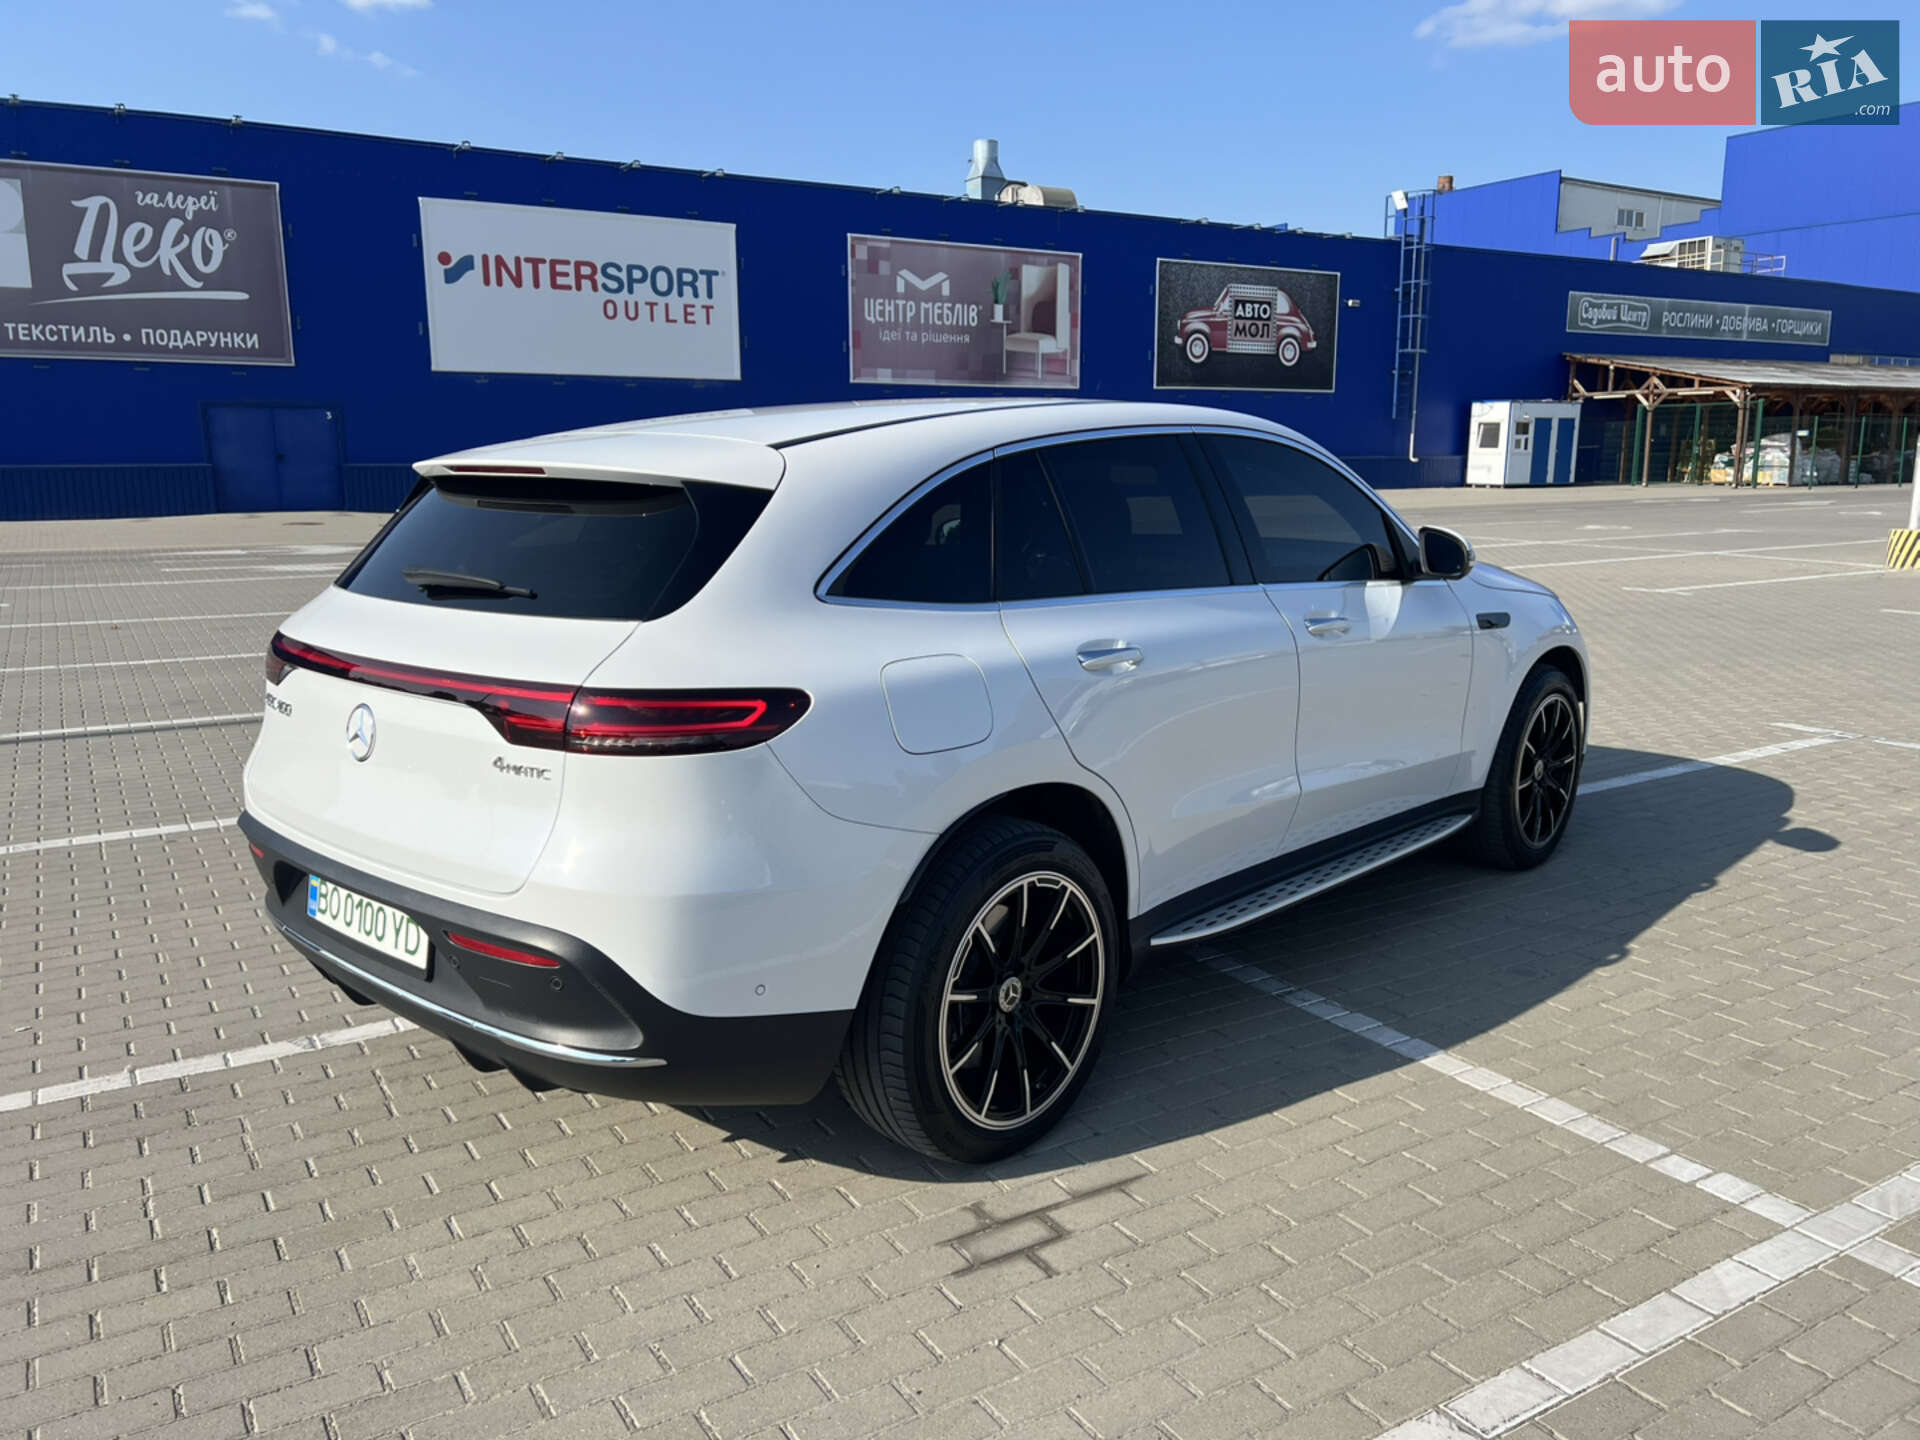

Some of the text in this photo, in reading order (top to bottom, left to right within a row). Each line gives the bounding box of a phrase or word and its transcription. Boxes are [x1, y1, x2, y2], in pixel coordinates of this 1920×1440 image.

[135, 189, 219, 220] галереї
[62, 195, 230, 291] Деко
[481, 253, 720, 300] INTERSPORT
[602, 299, 715, 326] OUTLET
[864, 297, 978, 327] ЦЕНТР МЕБЛІВ
[1235, 303, 1271, 319] АВТО
[1662, 311, 1822, 336] РОСЛИНИ ДОБРИВА ГОРЩИКИ
[4, 322, 260, 349] ТЕКСТИЛЬ ПОДАРУНКИ
[904, 331, 918, 342] та
[922, 329, 970, 345] рішення
[1234, 322, 1270, 339] МОЛ
[318, 879, 421, 956] BO 0100 YD
